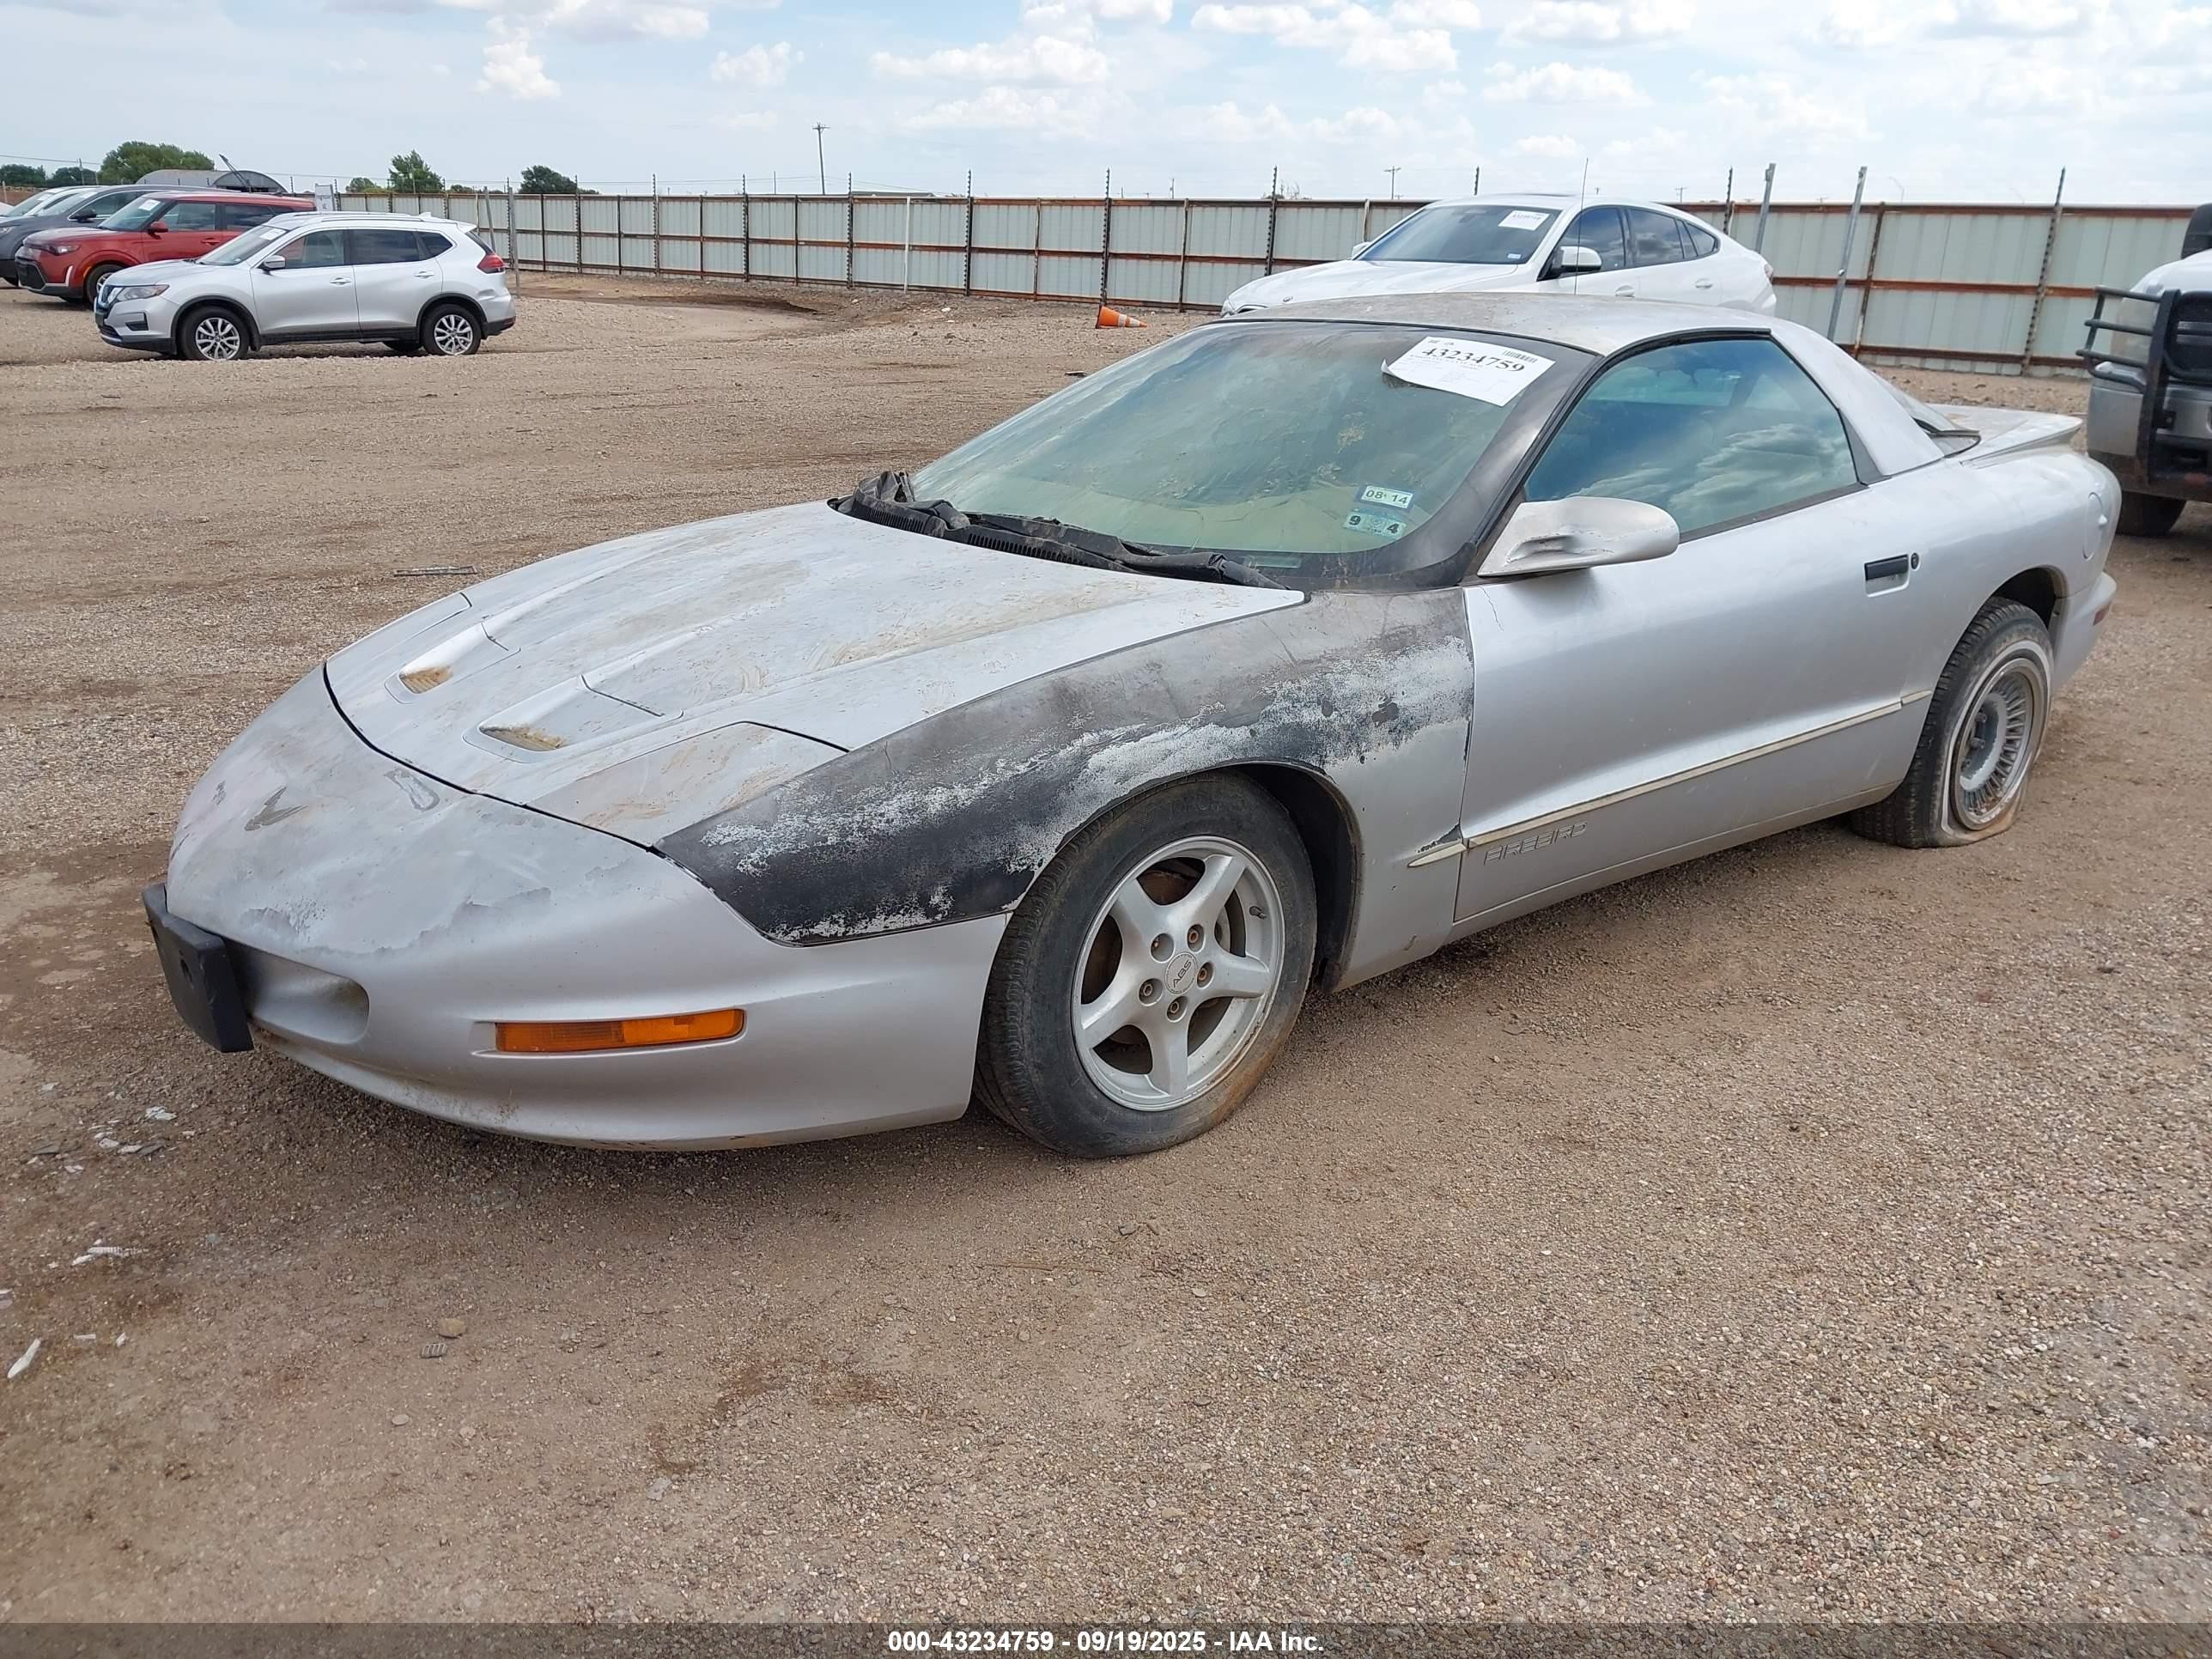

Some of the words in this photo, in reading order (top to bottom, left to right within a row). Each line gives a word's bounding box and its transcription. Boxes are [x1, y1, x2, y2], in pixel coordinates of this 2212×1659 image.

[1422, 347, 1525, 372] 43234759
[1392, 494, 1407, 503] 14
[1349, 515, 1361, 526] 9
[1387, 523, 1399, 533] 4
[1484, 822, 1587, 866] FIREBIRD
